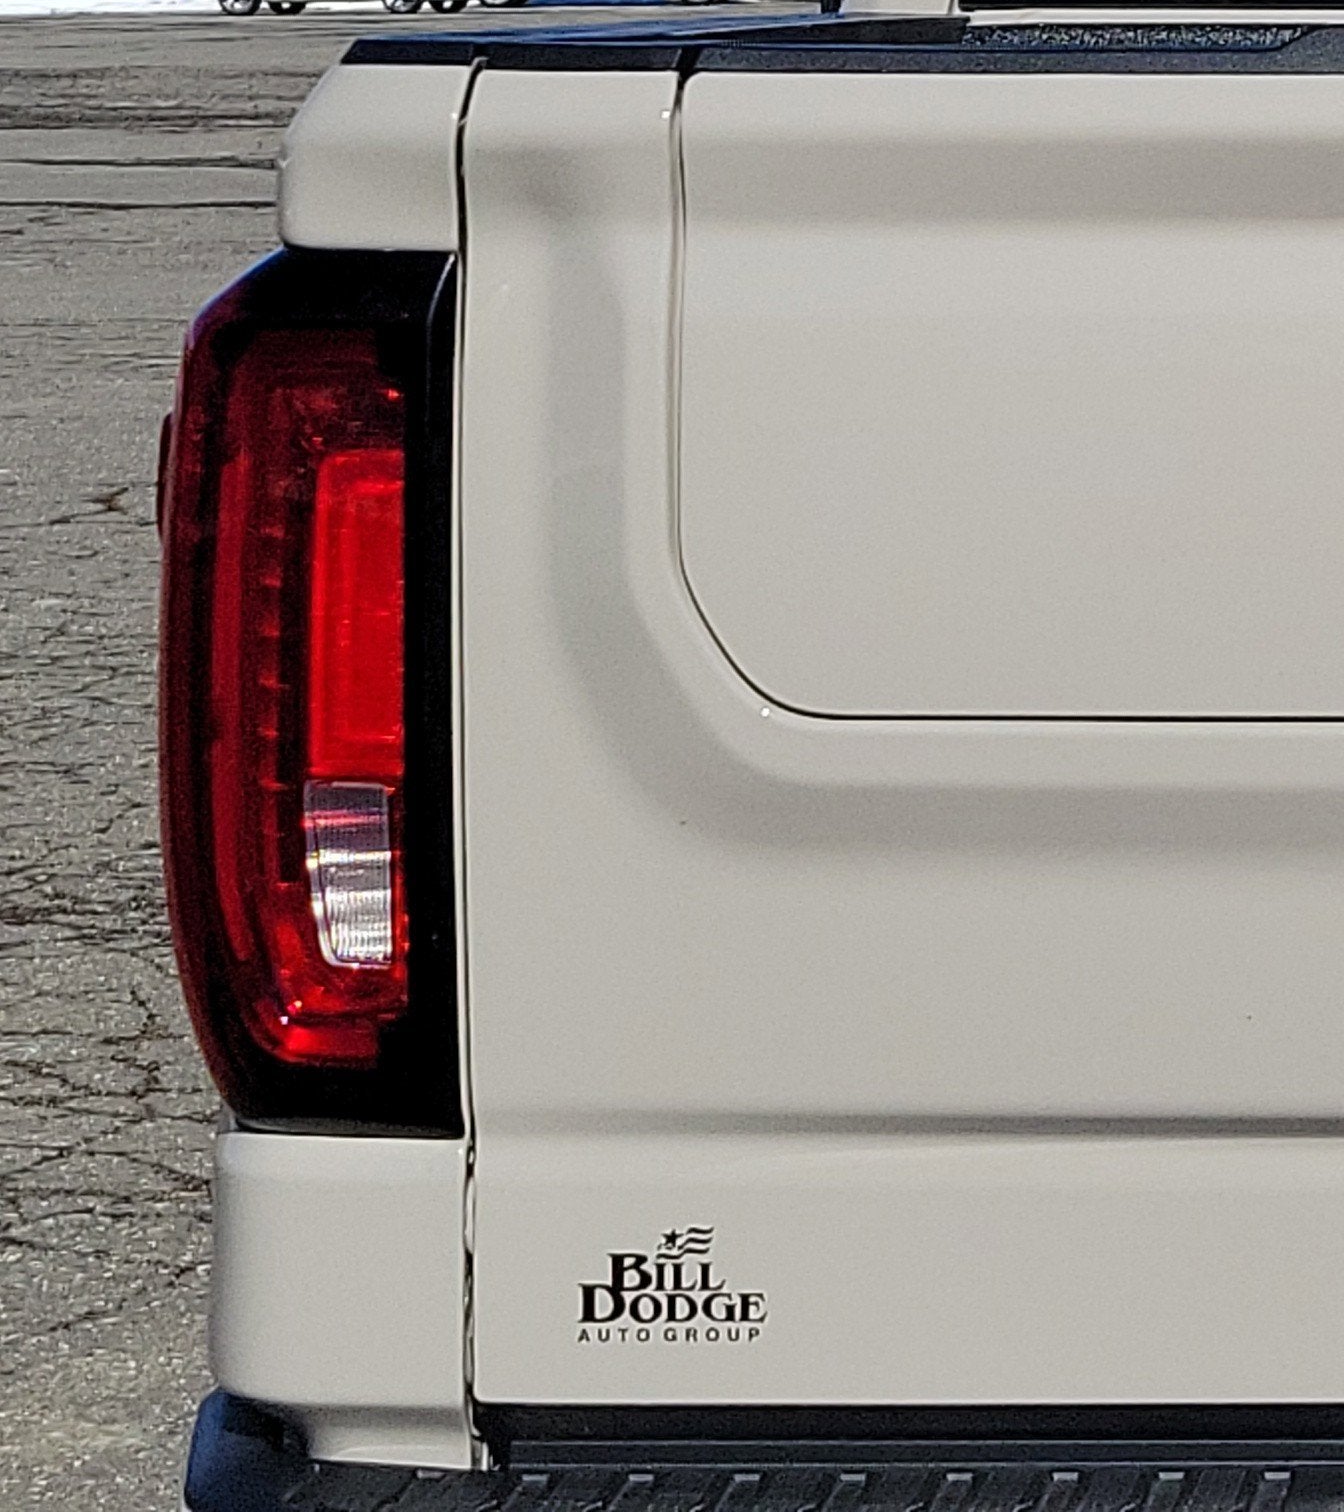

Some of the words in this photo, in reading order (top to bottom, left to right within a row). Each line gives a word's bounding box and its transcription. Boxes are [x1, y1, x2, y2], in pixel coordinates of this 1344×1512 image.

[607, 1252, 727, 1292] BILL
[577, 1282, 768, 1324] DODGE
[577, 1327, 651, 1343] AUTO
[663, 1327, 761, 1343] GROUP
